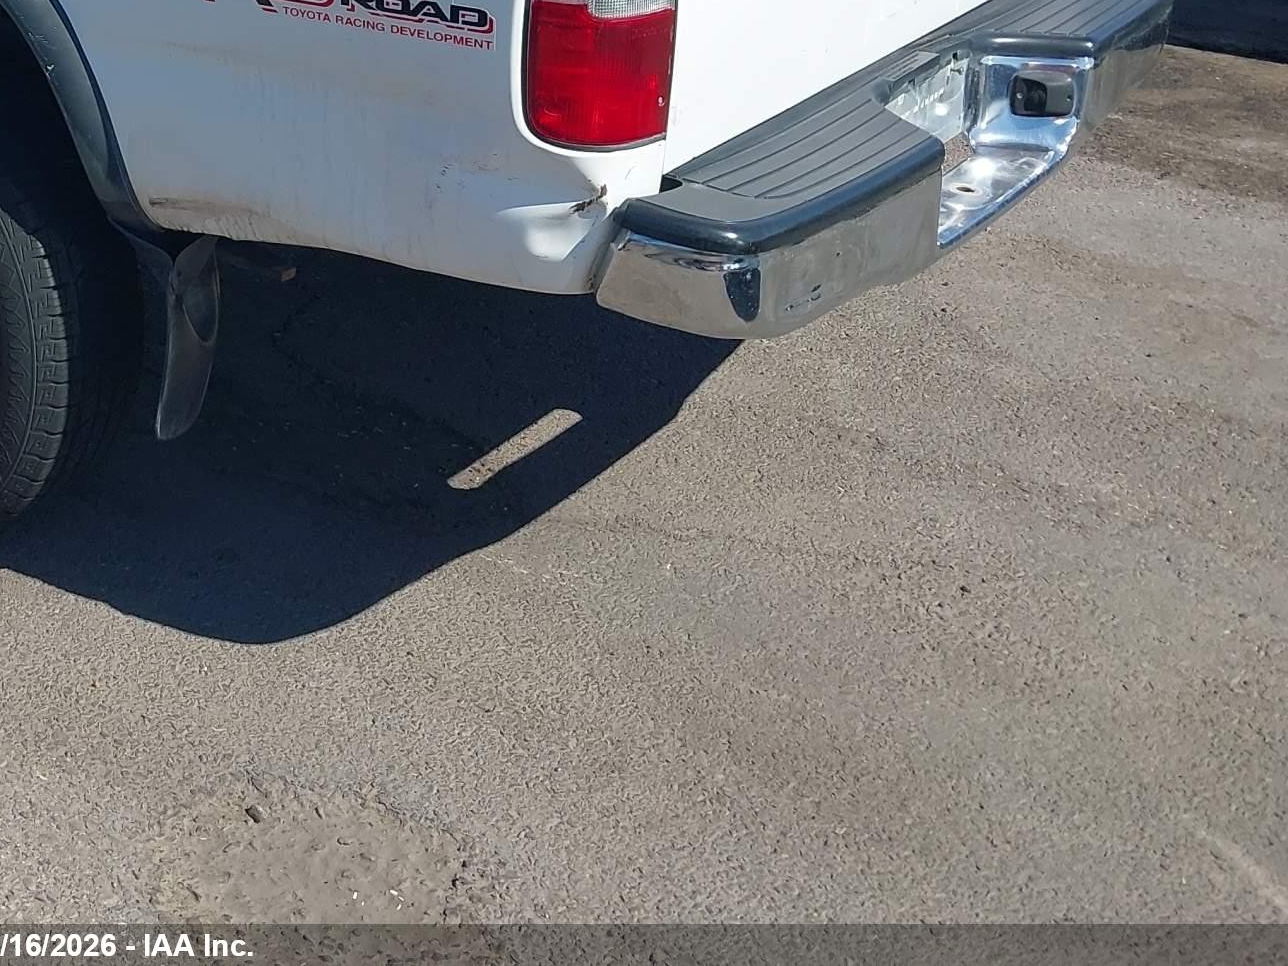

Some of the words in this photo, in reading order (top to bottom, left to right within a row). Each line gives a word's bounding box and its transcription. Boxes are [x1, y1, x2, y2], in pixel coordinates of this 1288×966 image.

[282, 5, 331, 24] TOYOTA
[335, 15, 386, 33] RACING
[390, 24, 494, 51] DEVELOPMENT
